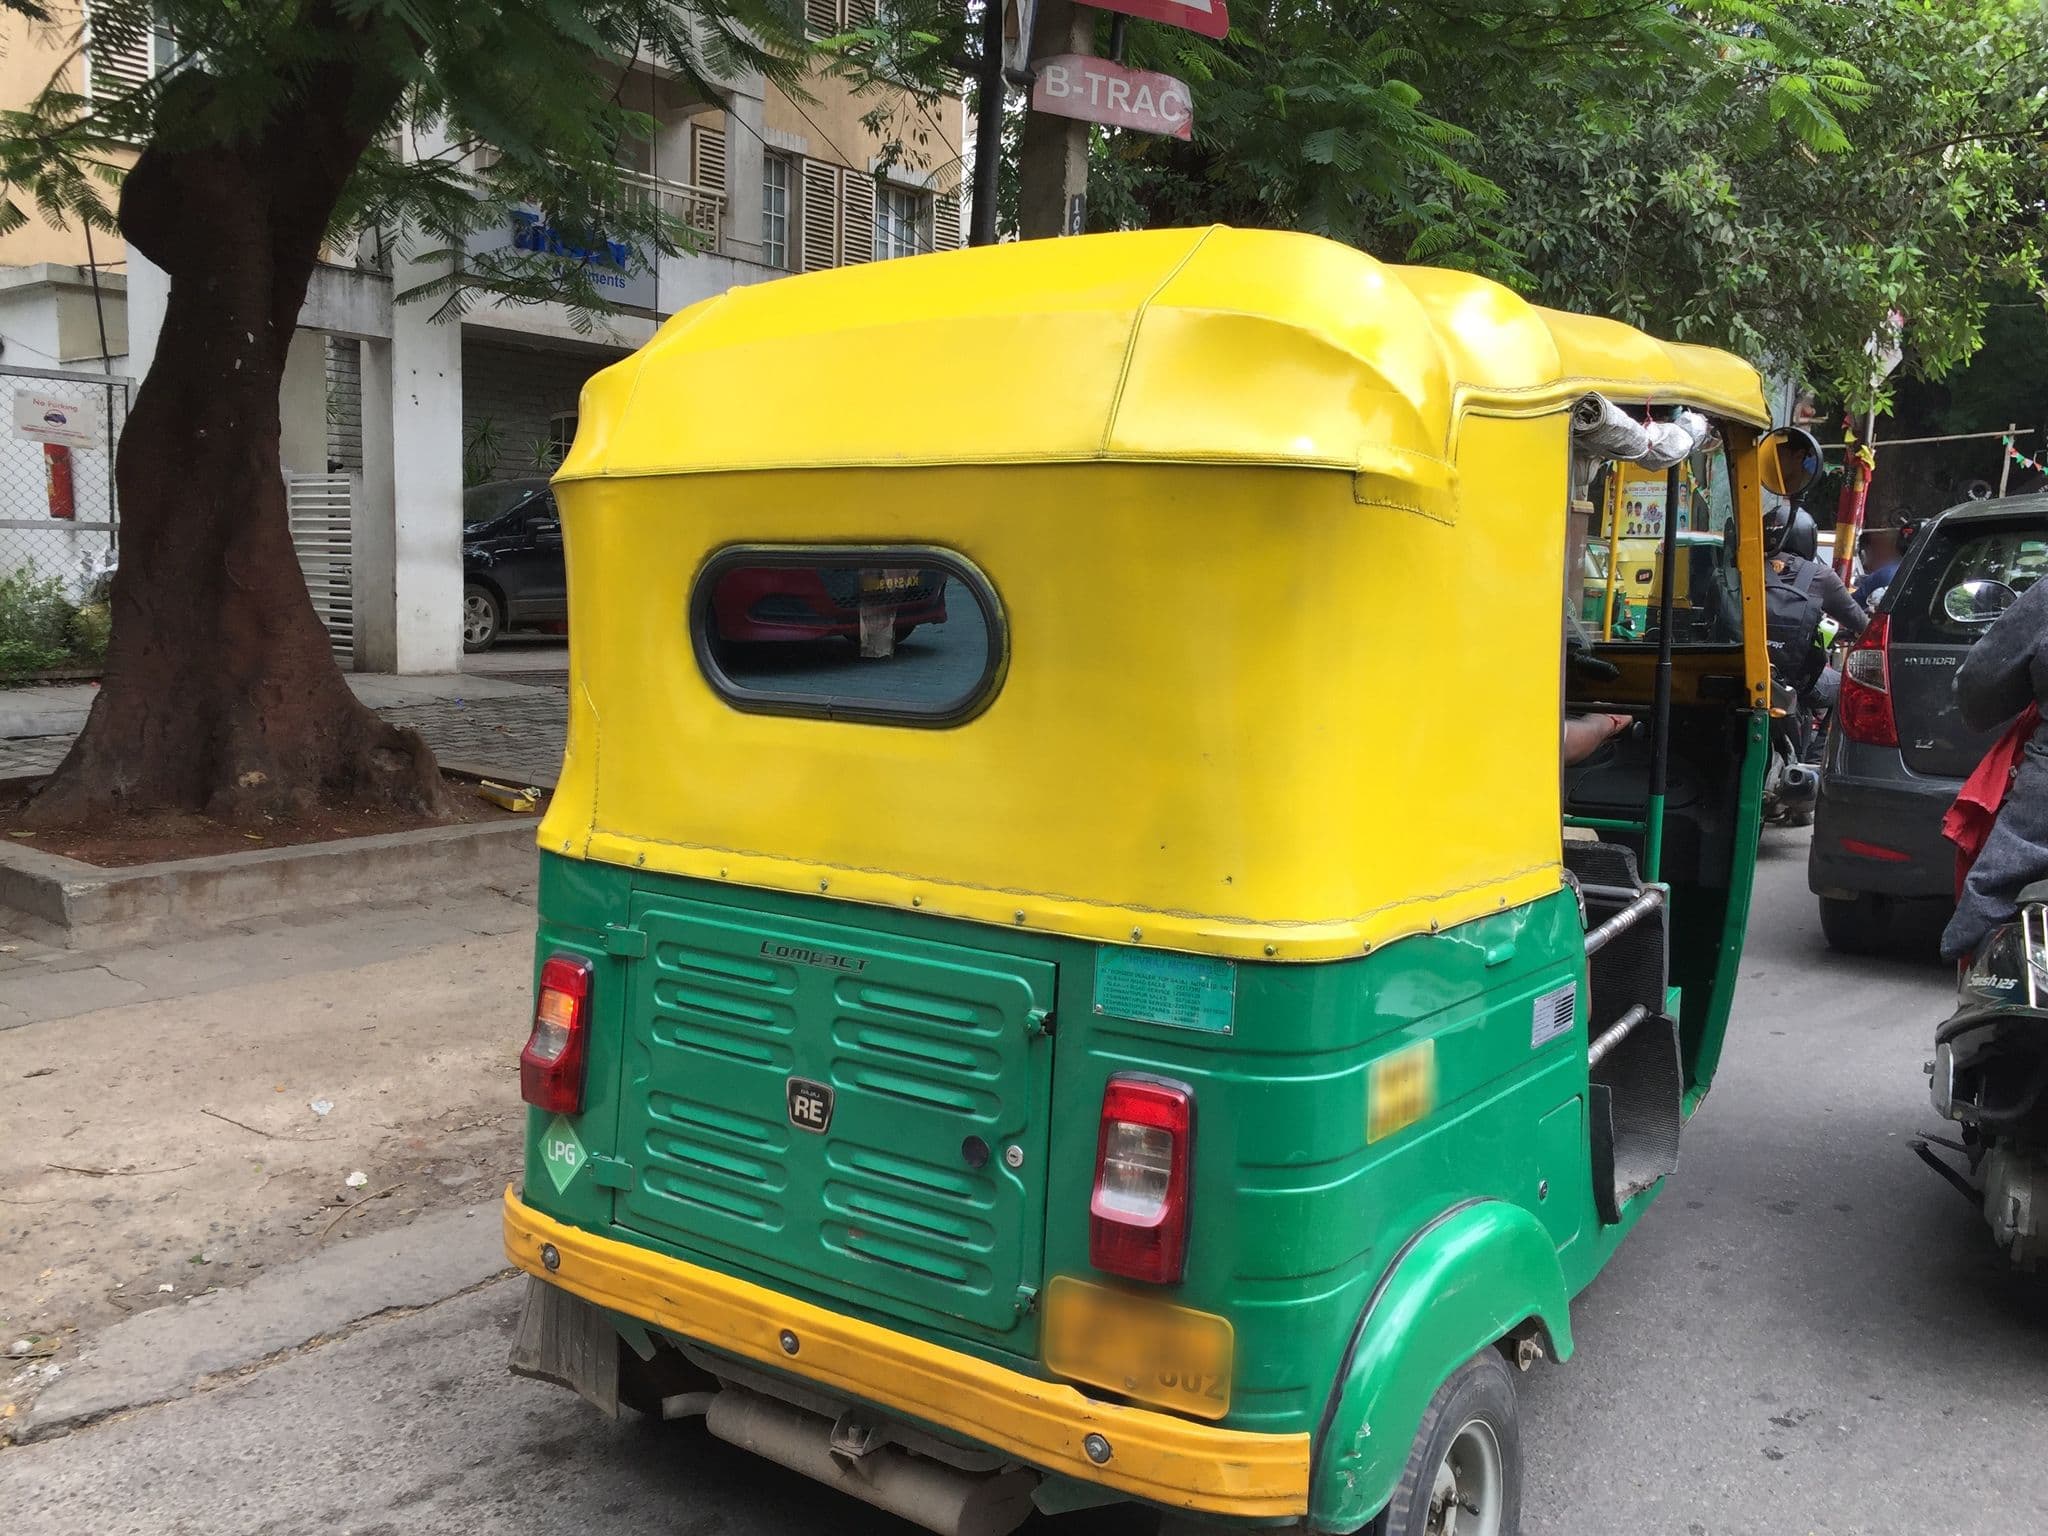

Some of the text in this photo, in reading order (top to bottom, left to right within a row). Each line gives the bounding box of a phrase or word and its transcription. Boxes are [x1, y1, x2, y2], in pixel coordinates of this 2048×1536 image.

[1045, 65, 1181, 122] B-TRAC
[1904, 657, 1956, 666] HYUNDAI
[795, 1094, 824, 1123] RE
[547, 1139, 576, 1166] LPG
